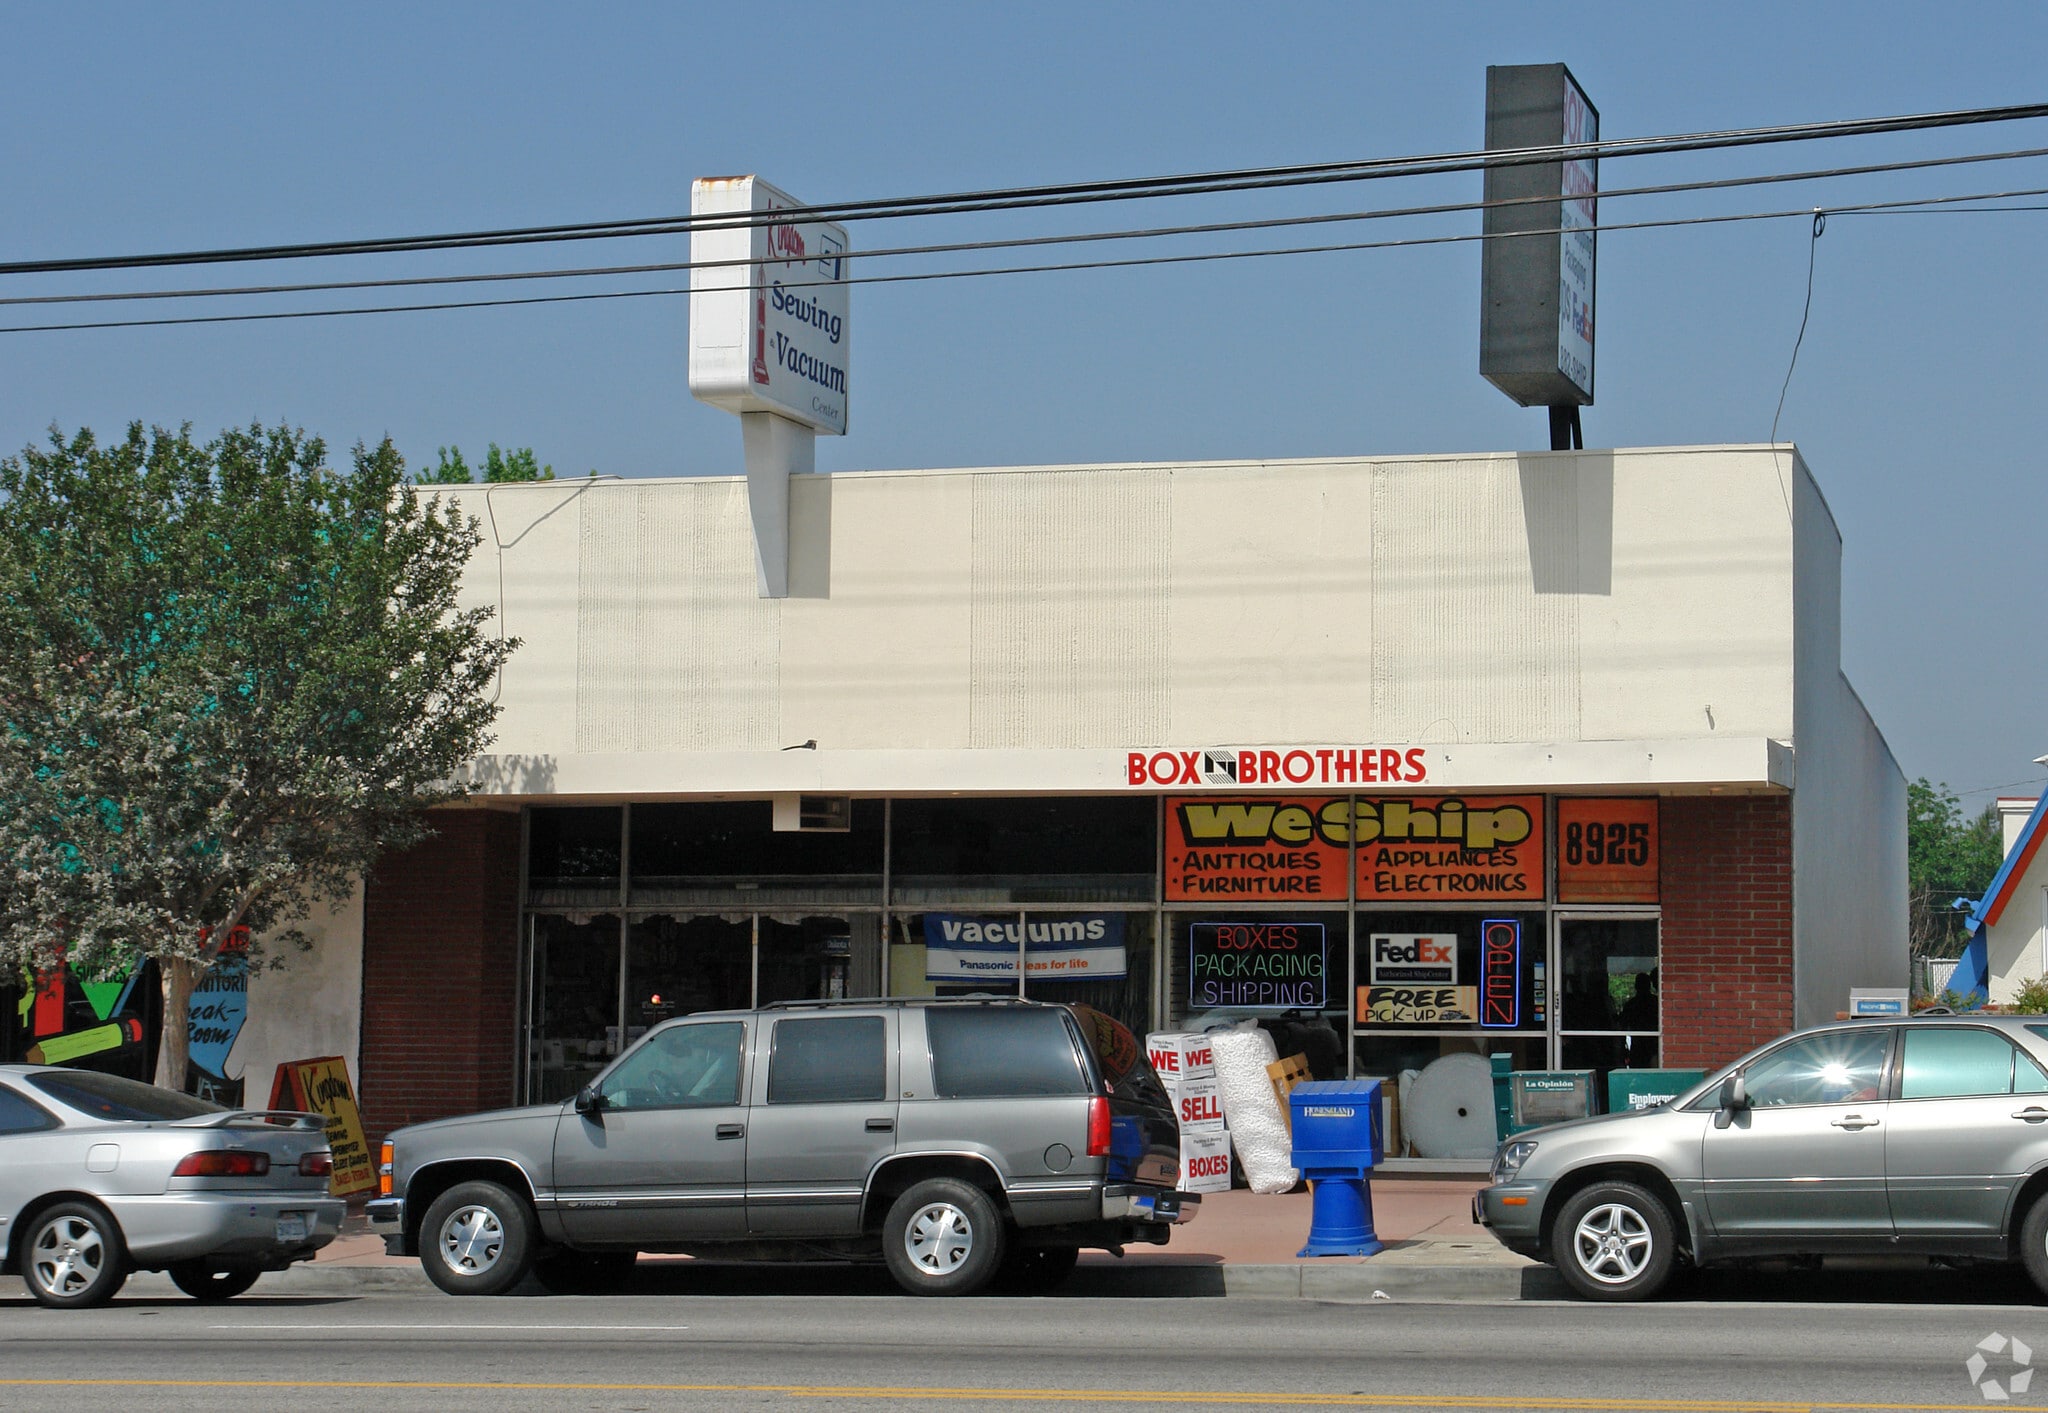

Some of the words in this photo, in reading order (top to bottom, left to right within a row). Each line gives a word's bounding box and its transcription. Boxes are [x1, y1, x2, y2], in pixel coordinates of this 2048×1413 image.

[771, 279, 842, 344] Sewing
[1572, 291, 1593, 344] FedEx
[776, 330, 846, 395] Vacuum
[811, 395, 840, 420] Center
[1128, 751, 1202, 786] BOX
[1239, 748, 1427, 784] BROTHERS
[1566, 822, 1649, 866] 8925
[1182, 851, 1321, 872] ANTIQUES
[1375, 848, 1518, 868] APPLIANCES
[1182, 874, 1322, 893] FURNITURE
[1374, 871, 1527, 893] ELECTRONICS
[942, 919, 1106, 943] vacuums
[1217, 925, 1298, 950] BOXES
[1375, 938, 1453, 963] FedEx
[960, 959, 1014, 970] Panasonic
[1016, 960, 1048, 970] ieas
[1050, 959, 1066, 970] for
[1069, 958, 1088, 969] life
[1194, 953, 1323, 977] PACKAGING
[1486, 923, 1515, 1024] OPEN
[1204, 980, 1314, 1005] SHIPPING
[1366, 987, 1457, 1008] FREE
[1365, 1007, 1437, 1022] PICK-UP
[1149, 1048, 1180, 1072] WE
[1185, 1048, 1213, 1067] WE
[1538, 1080, 1574, 1089] Opinión
[1181, 1095, 1222, 1122] SELL
[1188, 1154, 1229, 1178] BOXES
